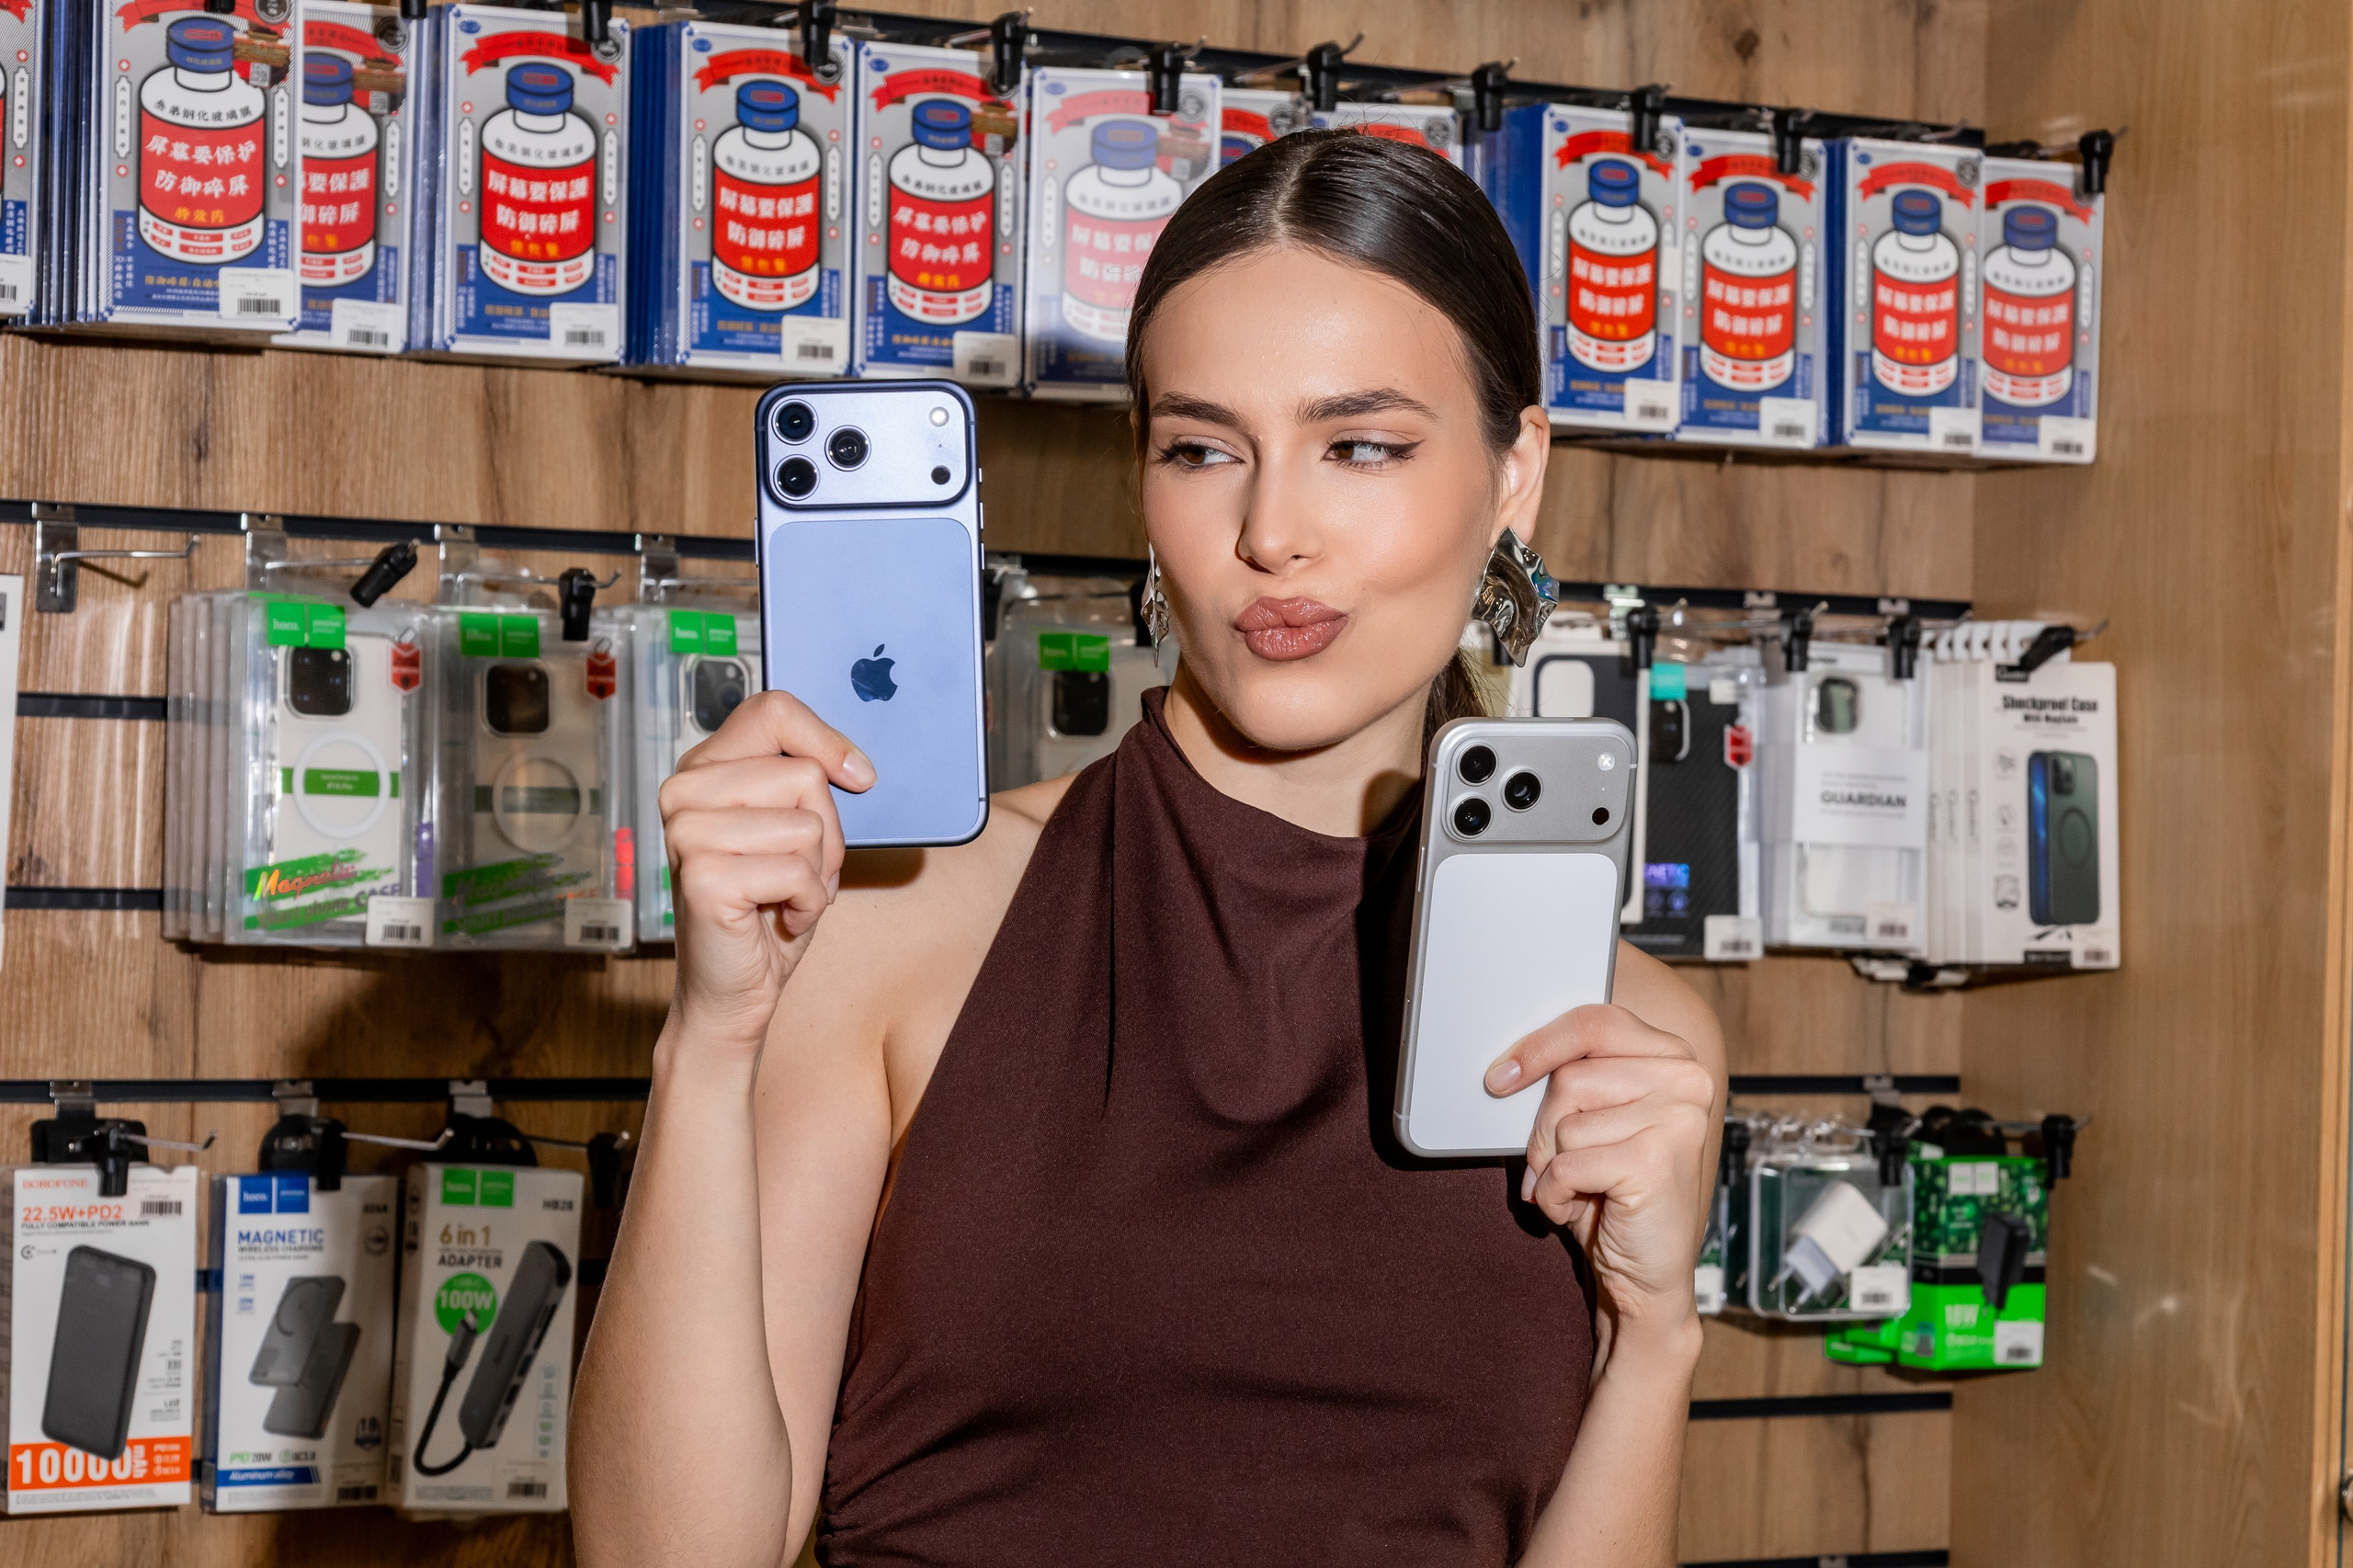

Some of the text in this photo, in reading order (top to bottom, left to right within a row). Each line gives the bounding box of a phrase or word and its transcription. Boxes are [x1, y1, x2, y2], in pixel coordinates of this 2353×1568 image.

[145, 135, 256, 164] 屏幕要保护
[154, 169, 249, 198] 防御碎屏
[1820, 790, 1907, 809] GUARDIAN
[22, 1177, 88, 1189] BOROFONE
[237, 1229, 324, 1244] MAGNETIC
[439, 1223, 491, 1245] 6 in 1
[438, 1255, 503, 1268] ADAPTER
[439, 1290, 494, 1310] 100W
[17, 1446, 132, 1484] 10000
[229, 1471, 273, 1482] Aluminum
